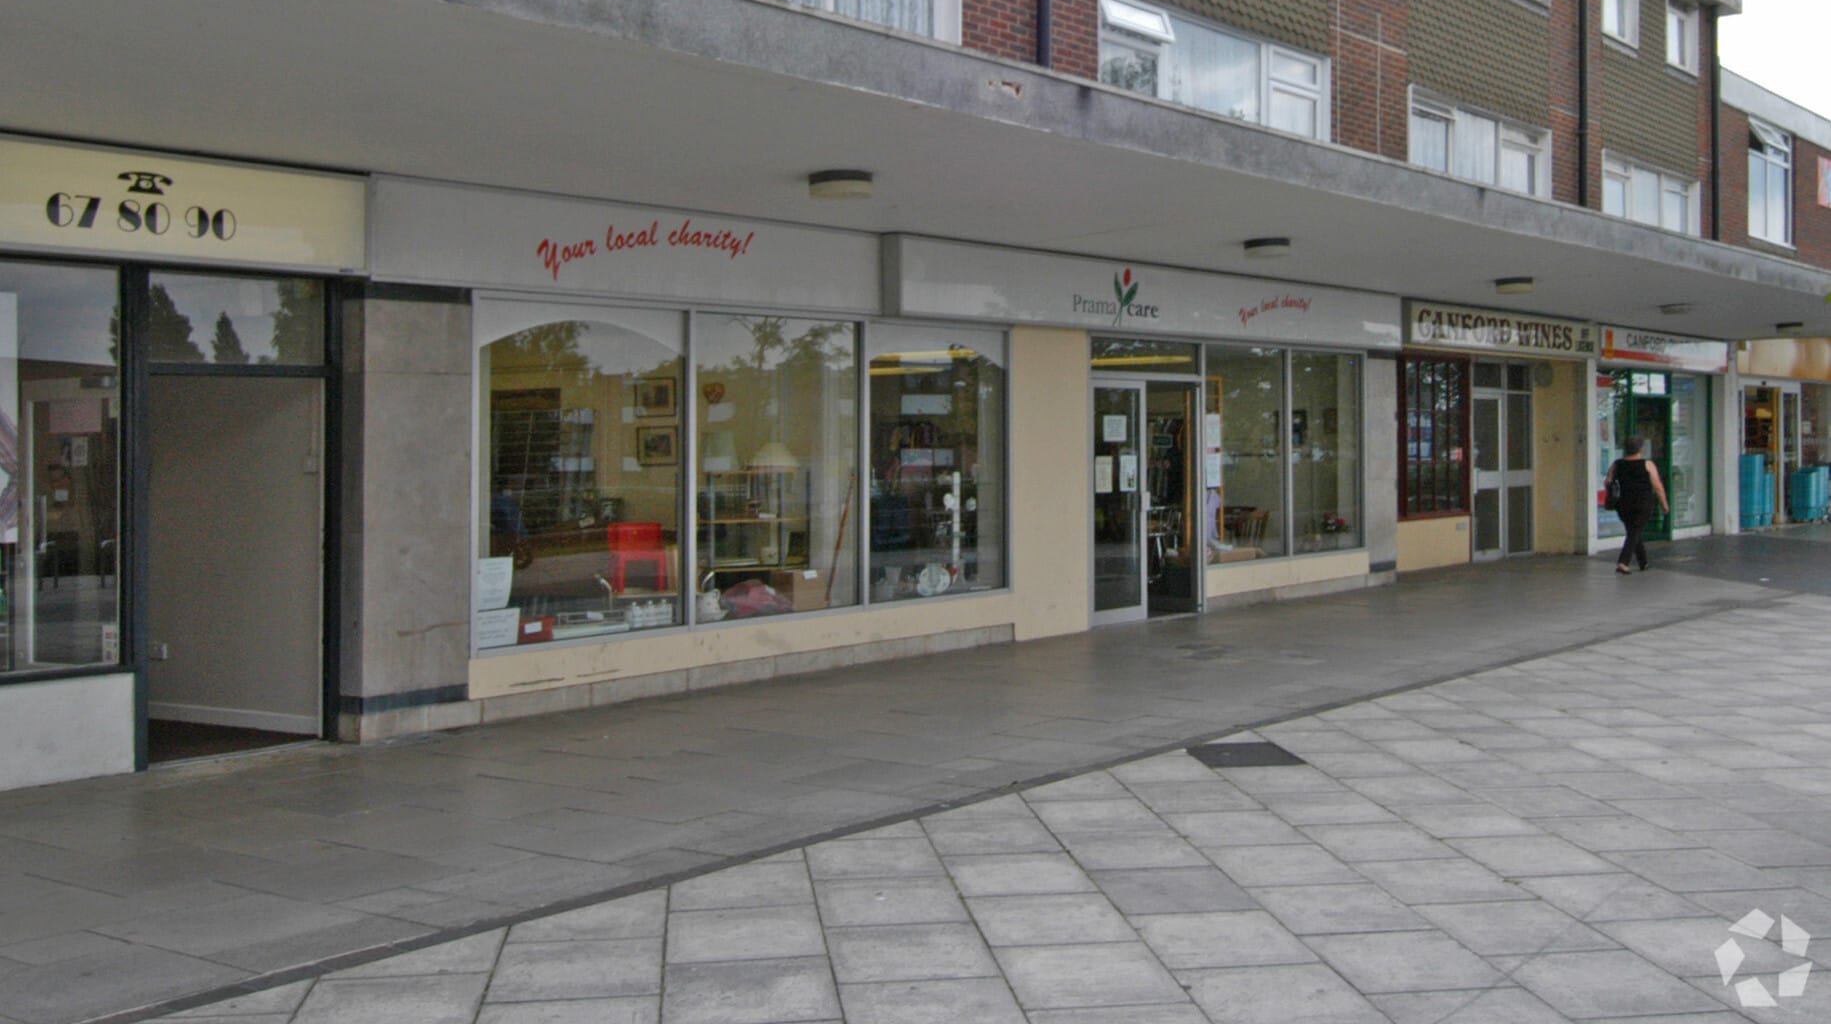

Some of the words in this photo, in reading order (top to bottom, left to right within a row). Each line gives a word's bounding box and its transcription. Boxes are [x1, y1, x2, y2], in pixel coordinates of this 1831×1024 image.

[46, 192, 102, 228] 67
[117, 199, 171, 235] 80
[184, 206, 237, 241] 90
[536, 238, 596, 281] Your
[606, 221, 657, 251] local
[667, 219, 754, 259] charity!
[1072, 294, 1117, 315] Prama
[1127, 303, 1159, 318] care
[1418, 308, 1511, 346] CANFORD
[1516, 321, 1573, 351] WINES
